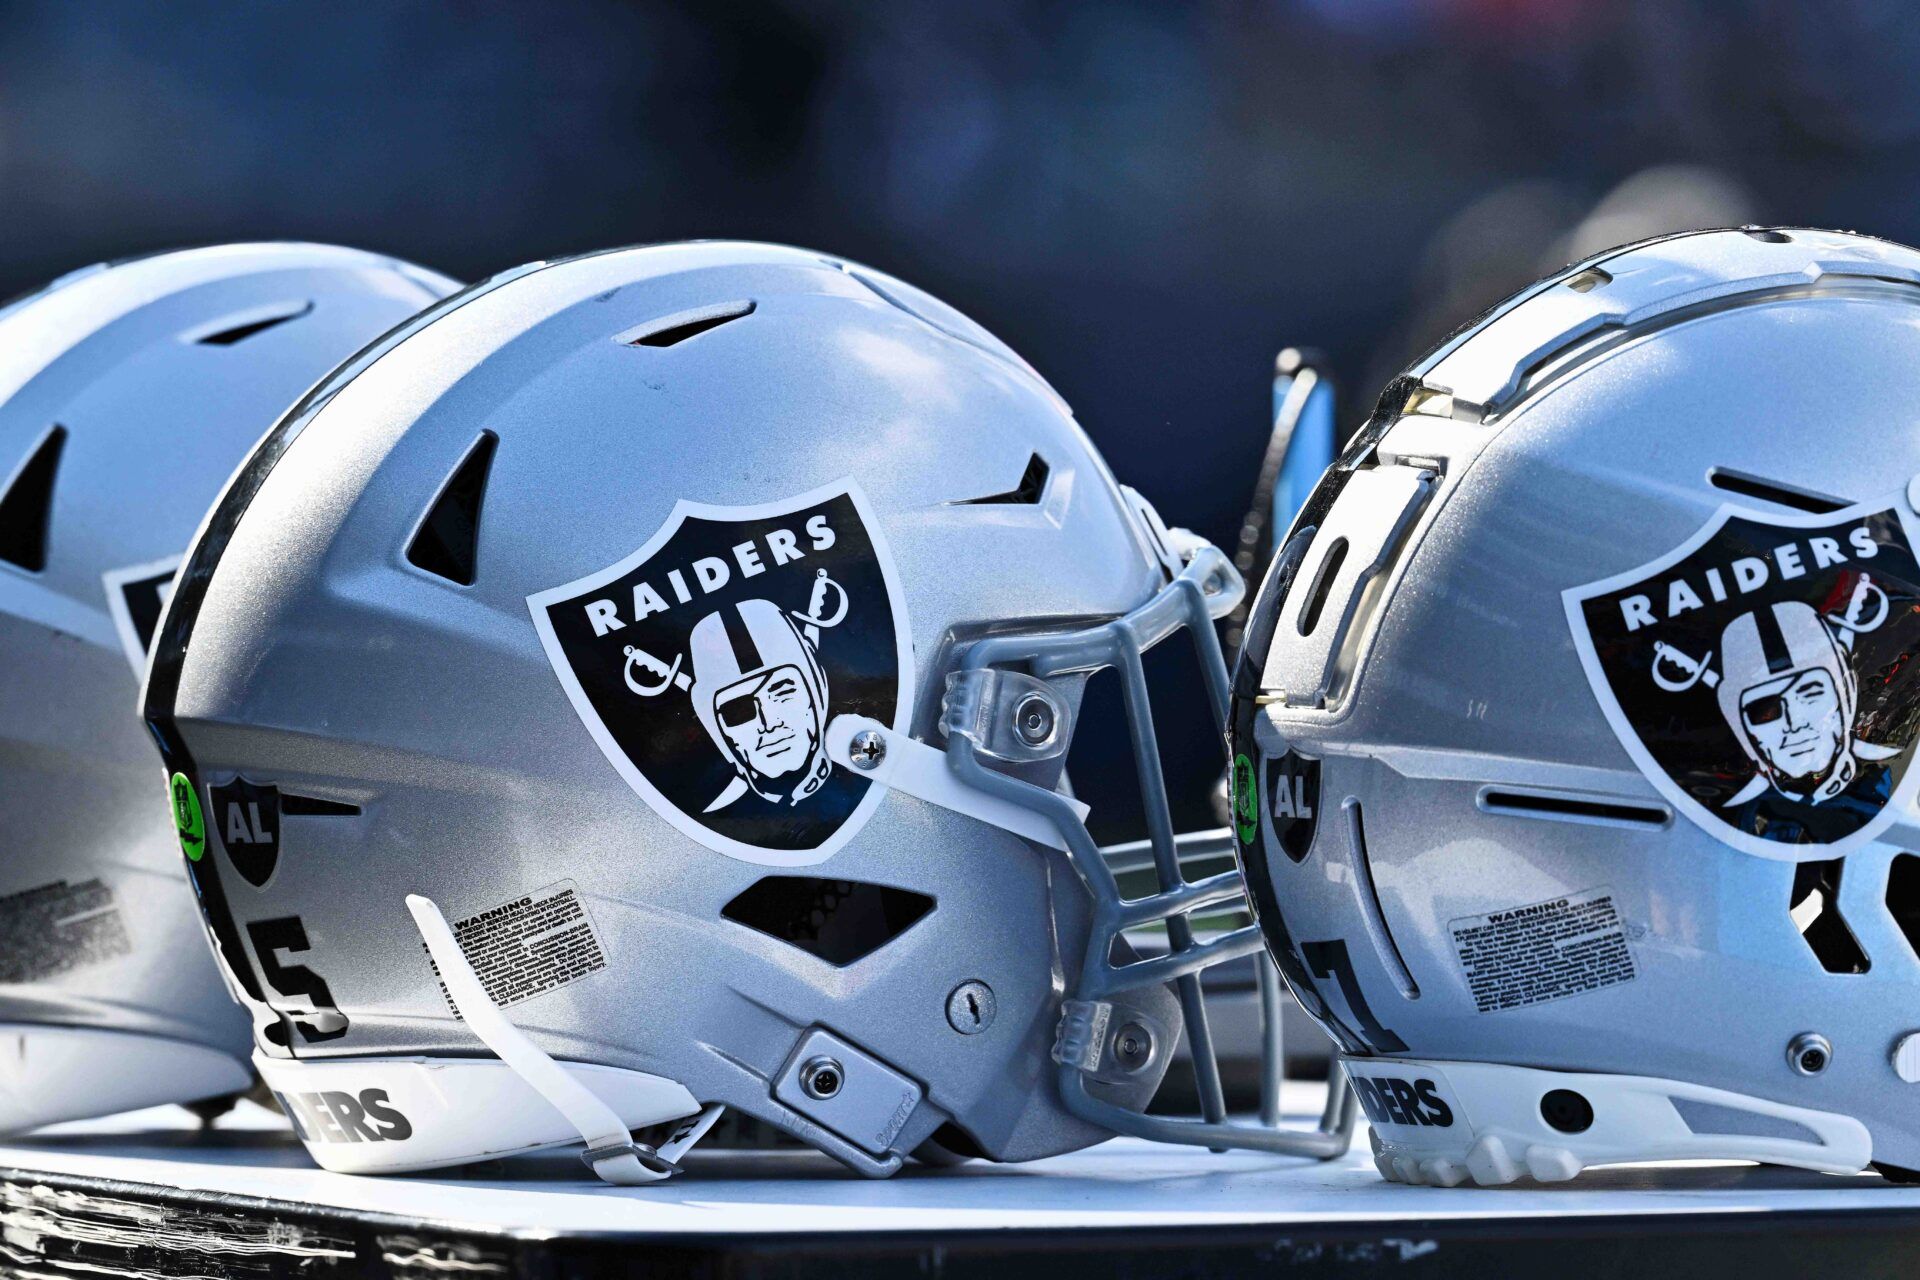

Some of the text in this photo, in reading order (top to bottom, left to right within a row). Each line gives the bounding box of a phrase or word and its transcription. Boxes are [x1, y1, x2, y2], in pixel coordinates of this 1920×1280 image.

[584, 515, 837, 638] RAIDERS
[1619, 528, 1879, 632] RAIDERS
[1274, 774, 1312, 819] AL
[227, 802, 273, 844] AL
[455, 897, 531, 929] WARNING
[509, 908, 524, 918] HEAD
[524, 904, 533, 912] OR
[533, 899, 549, 908] NECK
[573, 912, 583, 920] you
[1488, 900, 1568, 923] WARNING
[246, 916, 350, 1043] 5
[510, 994, 524, 1002] more
[526, 984, 547, 996] serious
[1300, 938, 1410, 1053] 7
